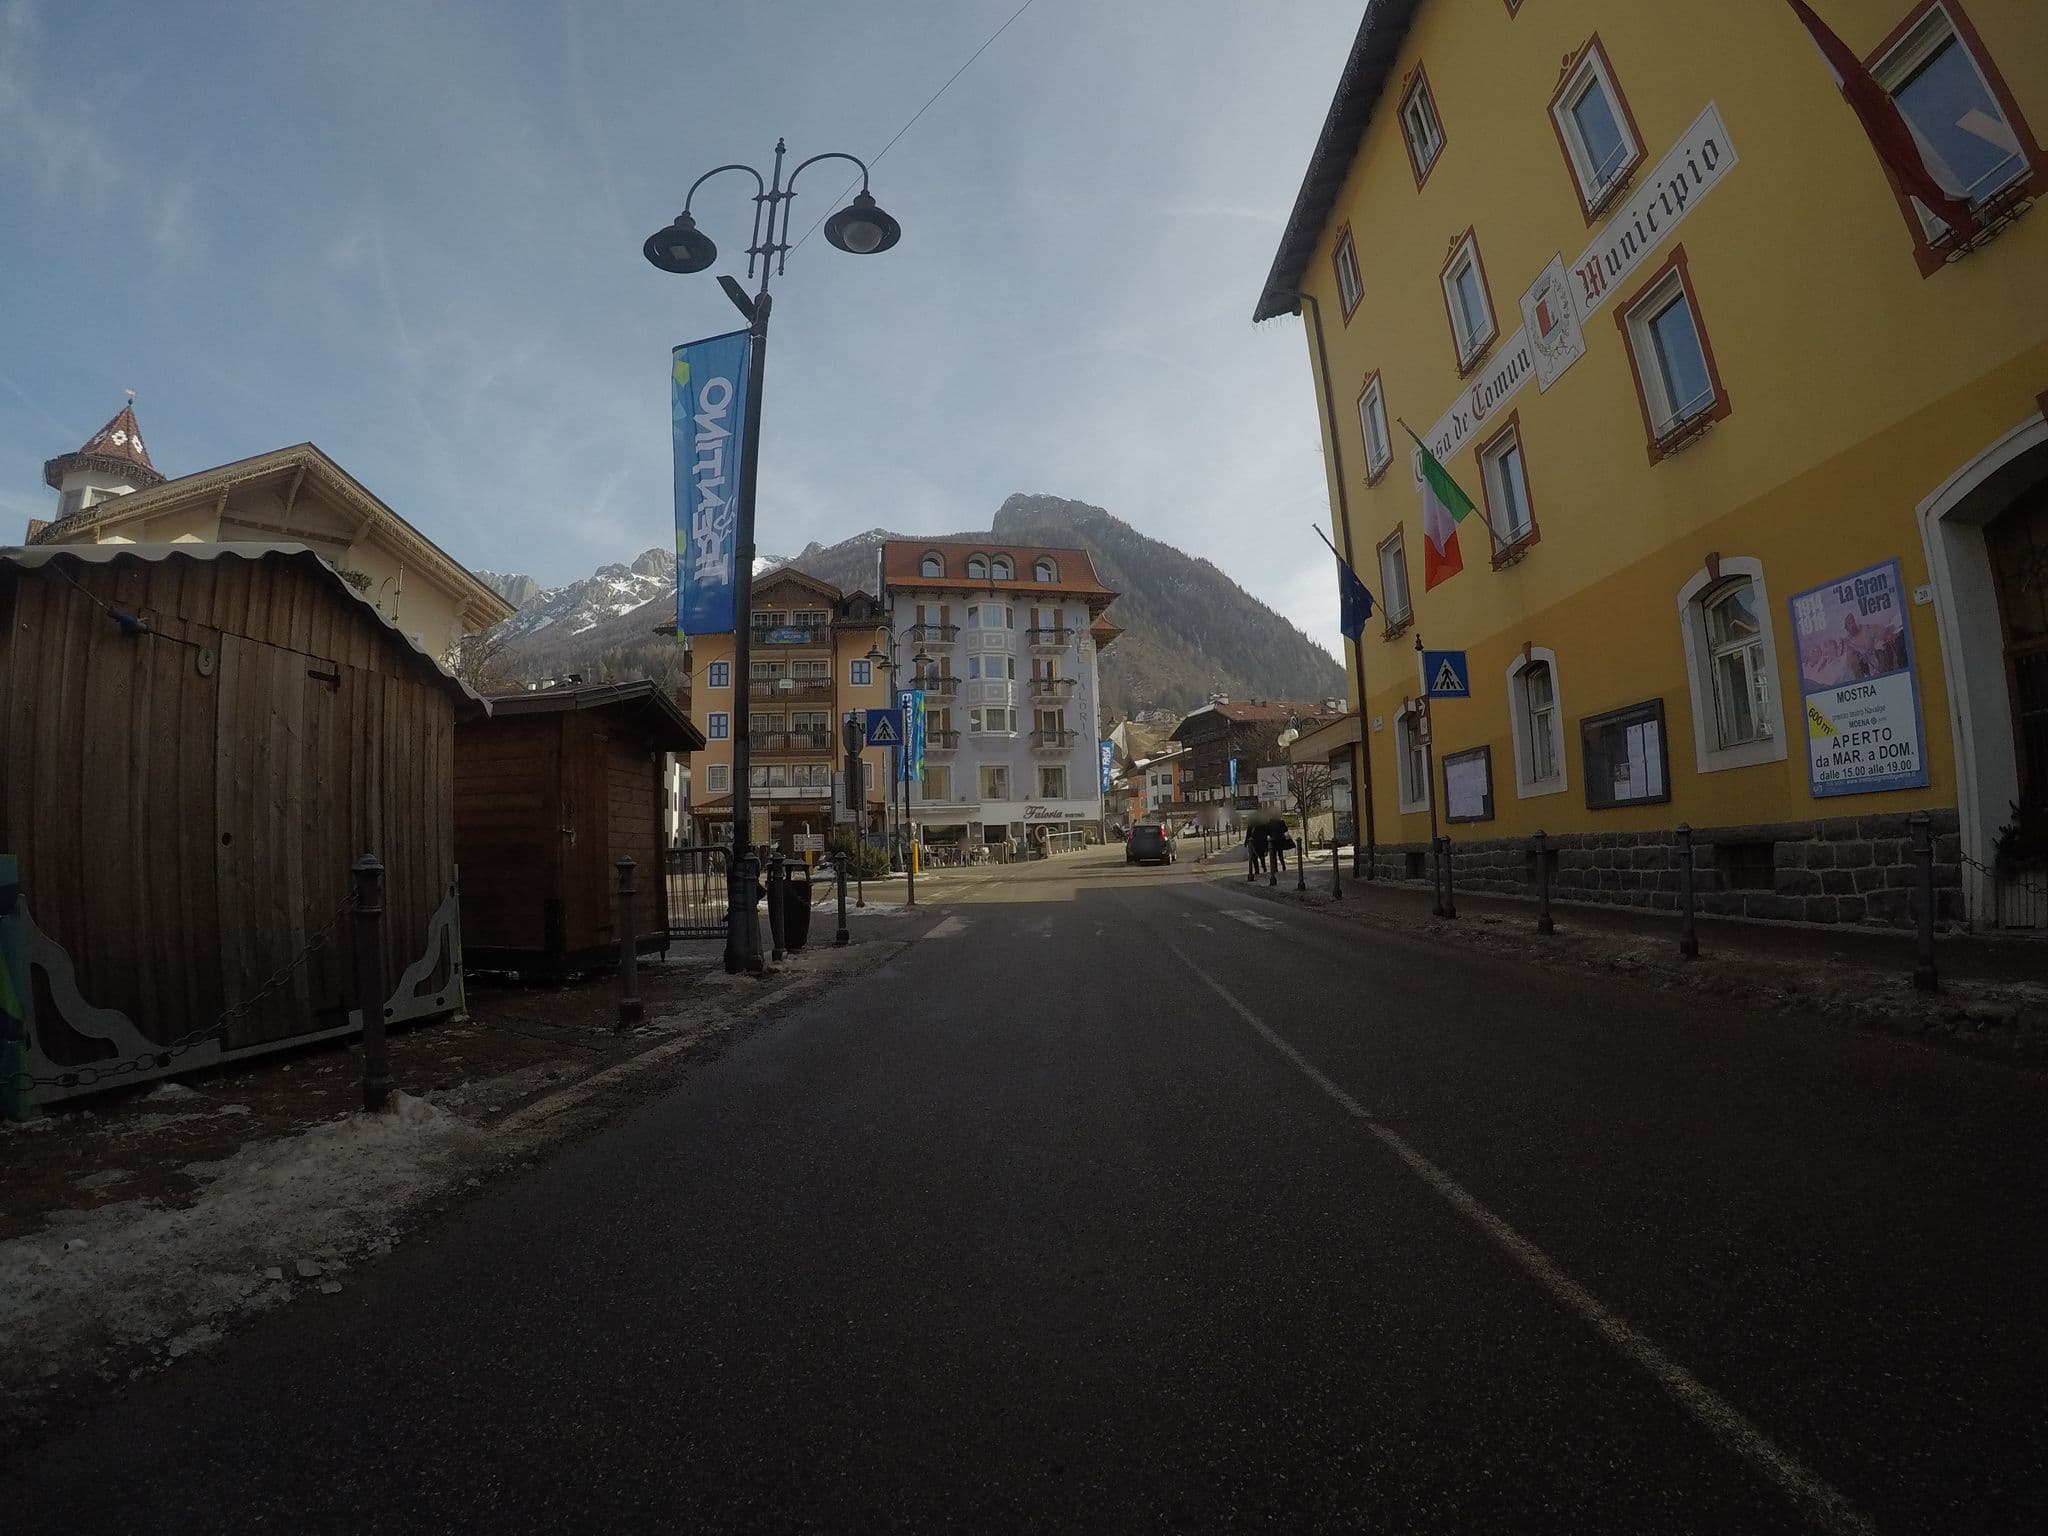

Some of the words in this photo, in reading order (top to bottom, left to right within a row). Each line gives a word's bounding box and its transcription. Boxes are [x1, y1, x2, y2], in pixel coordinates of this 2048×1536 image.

[1576, 138, 1720, 310] Municipio
[1452, 412, 1469, 440] de
[1472, 348, 1531, 421] Comun
[1854, 573, 1888, 598] Gran
[1837, 684, 1878, 704] MOSTRA
[1808, 706, 1823, 726] 600
[1849, 718, 1871, 728] MOENA
[1832, 727, 1893, 750] APERTO
[1816, 754, 1830, 768] da
[1832, 749, 1864, 766] MAR.
[1868, 751, 1875, 761] a
[1879, 742, 1914, 760] DOM.
[1820, 768, 1840, 781] dalle
[1842, 765, 1866, 778] 15.00
[1867, 763, 1885, 775] alle
[1887, 759, 1912, 773] 19.00
[1023, 805, 1063, 819] Faloria
